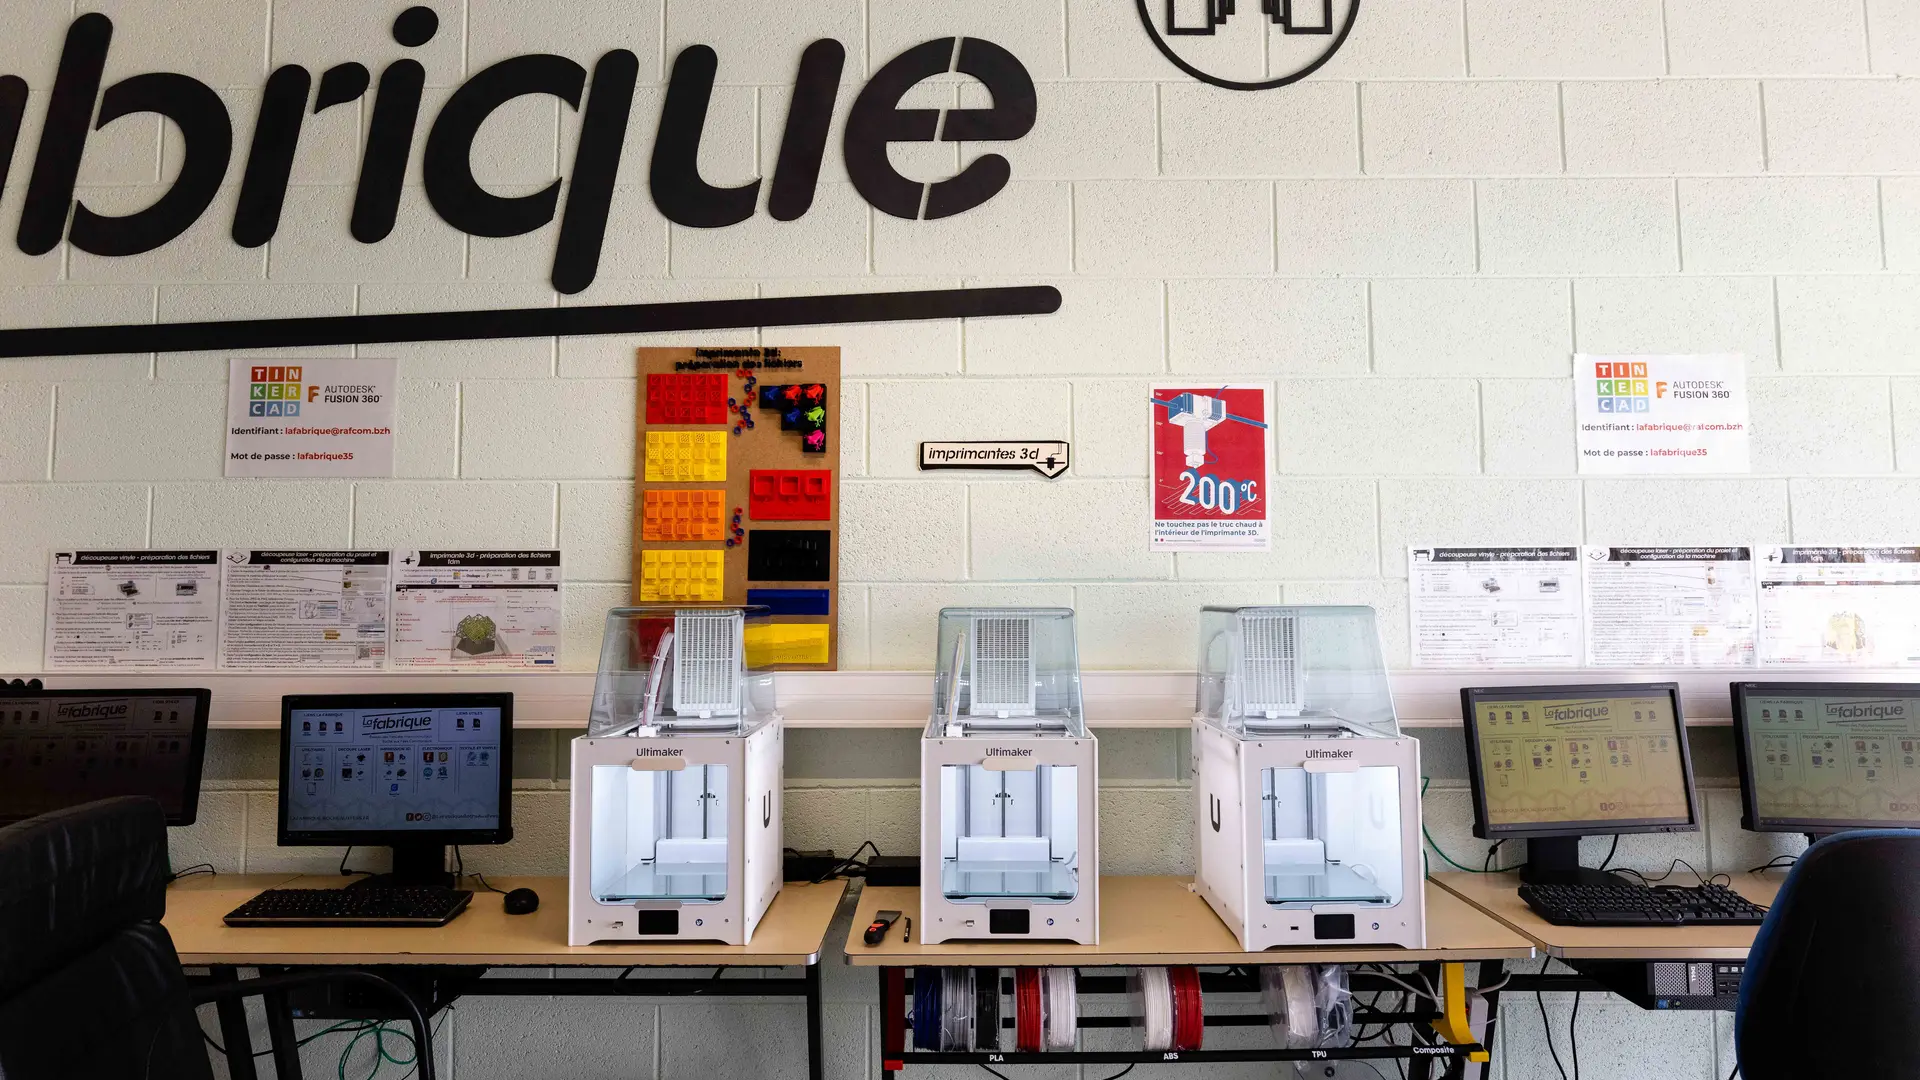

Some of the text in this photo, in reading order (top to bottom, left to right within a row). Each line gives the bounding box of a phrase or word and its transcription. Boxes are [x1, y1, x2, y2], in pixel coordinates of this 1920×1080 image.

[0, 6, 1037, 294] brique
[255, 368, 300, 380] TIN
[1598, 364, 1646, 376] TIN
[253, 386, 298, 398] KER
[1599, 381, 1646, 394] KER
[324, 395, 380, 403] FUSION 360
[1673, 391, 1730, 399] FUSION 360
[252, 403, 297, 415] CAD
[1600, 399, 1647, 411] CAD
[231, 427, 278, 435] Identifiant
[285, 427, 391, 437] lafabrique@rafcom.bzh
[1581, 423, 1631, 431] Identifiant
[230, 452, 248, 460] Mot
[250, 452, 263, 460] de
[297, 452, 354, 461] lafabrique35
[928, 447, 1039, 461] imprimantes 3d
[1583, 449, 1601, 457] Mot
[1603, 449, 1615, 457] de
[1617, 450, 1644, 458] passe
[1650, 449, 1708, 458] lafabrique35
[1201, 529, 1246, 537] l'imprimante
[67, 704, 128, 719] fabrique
[1544, 706, 1609, 721] La fabrique
[1826, 704, 1904, 719] La fabrique
[362, 715, 432, 730] La fabrique
[636, 747, 684, 757] Ultimaker
[985, 747, 1033, 757] Ultimaker
[1305, 748, 1353, 759] Ultimaker
[1311, 1050, 1328, 1059] TPU
[1413, 1046, 1455, 1055] Composite
[989, 1054, 1004, 1063] PLA
[1163, 1052, 1179, 1061] ABS
